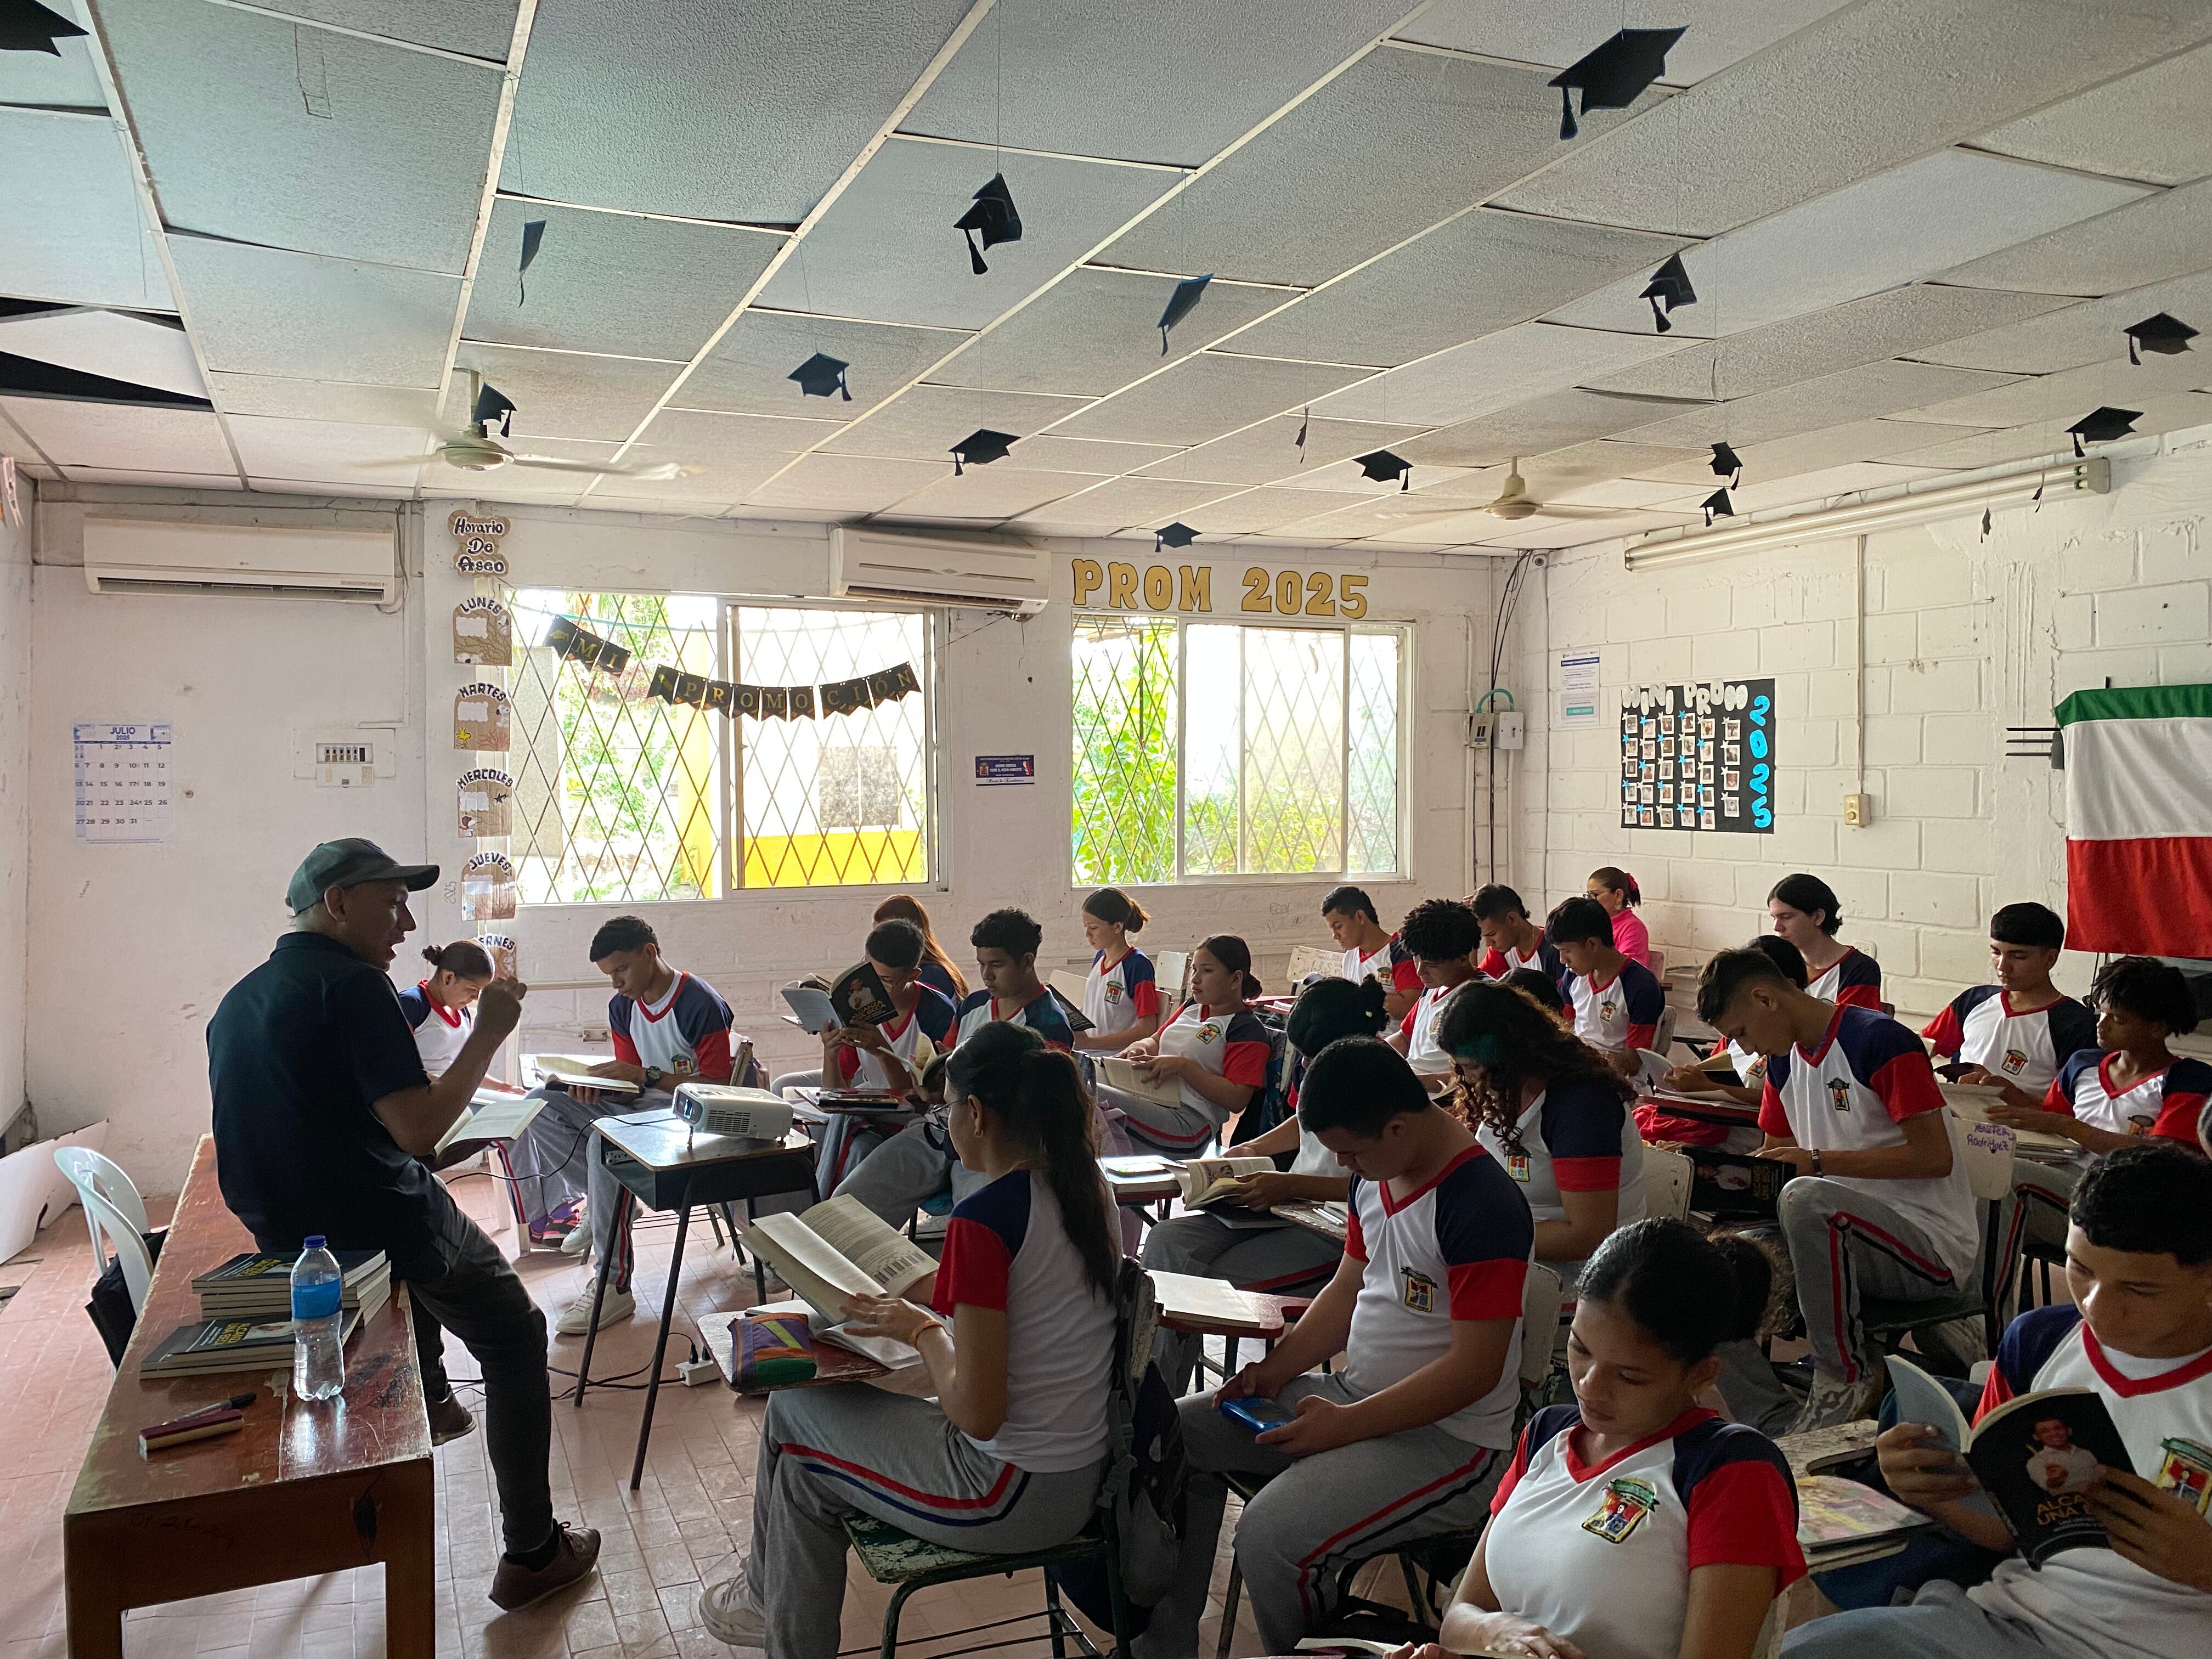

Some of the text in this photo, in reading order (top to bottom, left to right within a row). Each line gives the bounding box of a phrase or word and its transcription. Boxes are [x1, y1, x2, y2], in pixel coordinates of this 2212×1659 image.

[454, 518, 504, 535] Horario
[467, 537, 494, 555] De
[458, 556, 504, 573] Aseo
[1072, 558, 1368, 619] PROM 2025
[460, 597, 502, 614] LUNES
[574, 638, 617, 669] MI
[460, 684, 506, 702] MARTES
[1622, 679, 1748, 715] MINI PROM
[1750, 695, 1772, 828] 2025
[458, 769, 513, 789] MIERCOLES
[470, 853, 511, 871] JUEVES
[478, 935, 515, 950] ERNES
[2037, 1506, 2081, 1525] UNA
